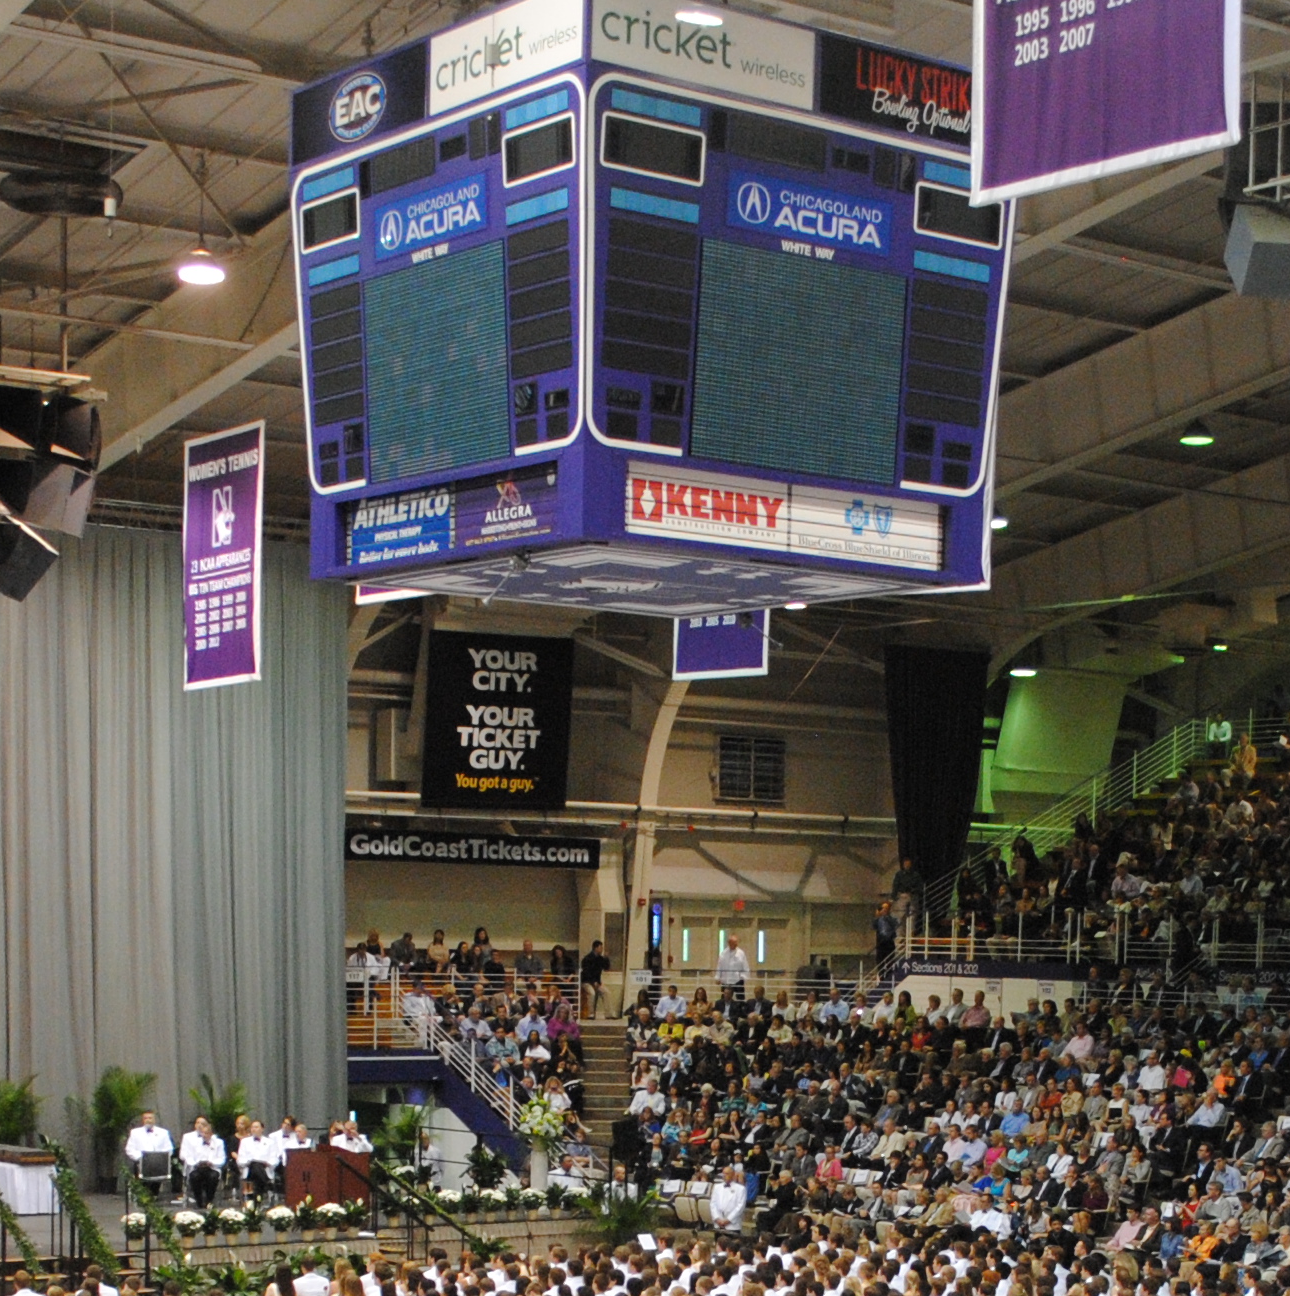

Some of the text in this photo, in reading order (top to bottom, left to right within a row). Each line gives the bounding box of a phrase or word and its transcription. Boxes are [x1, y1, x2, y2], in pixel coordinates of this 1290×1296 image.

[1015, 0, 1095, 37] 1995 1996
[529, 24, 577, 56] wireless
[601, 11, 805, 88] cricket wireless
[1015, 23, 1095, 66] 2003 2007
[856, 47, 916, 100] LUCKY
[334, 84, 382, 128] EAC
[872, 88, 971, 134] Bowling Optional
[407, 184, 480, 219] CHICAGOLAND
[780, 190, 882, 224] CHICAGOLAND
[405, 200, 481, 244] ACURA
[773, 208, 881, 249] ACURA
[781, 240, 835, 261] WHITE WAY
[189, 448, 259, 482] WOMEN'S TENNIS
[354, 488, 449, 530] ATHLETICO
[485, 504, 532, 523] ALLEGRA
[666, 482, 784, 529] KENNY
[665, 518, 777, 539] CONSTRUCTION COMPANY
[797, 534, 843, 551] BlueCross
[844, 541, 890, 557] BlueShield
[468, 647, 538, 671] YOUR
[472, 670, 531, 692] CITY.
[466, 705, 535, 728] YOUR
[457, 726, 541, 749] TICKET
[469, 749, 525, 770] GUY.
[456, 773, 534, 793] You got a guy.
[350, 833, 590, 863] GoldCoastTickets.com
[912, 962, 942, 973] Sections
[944, 963, 956, 974] 201
[964, 964, 978, 974] 202
